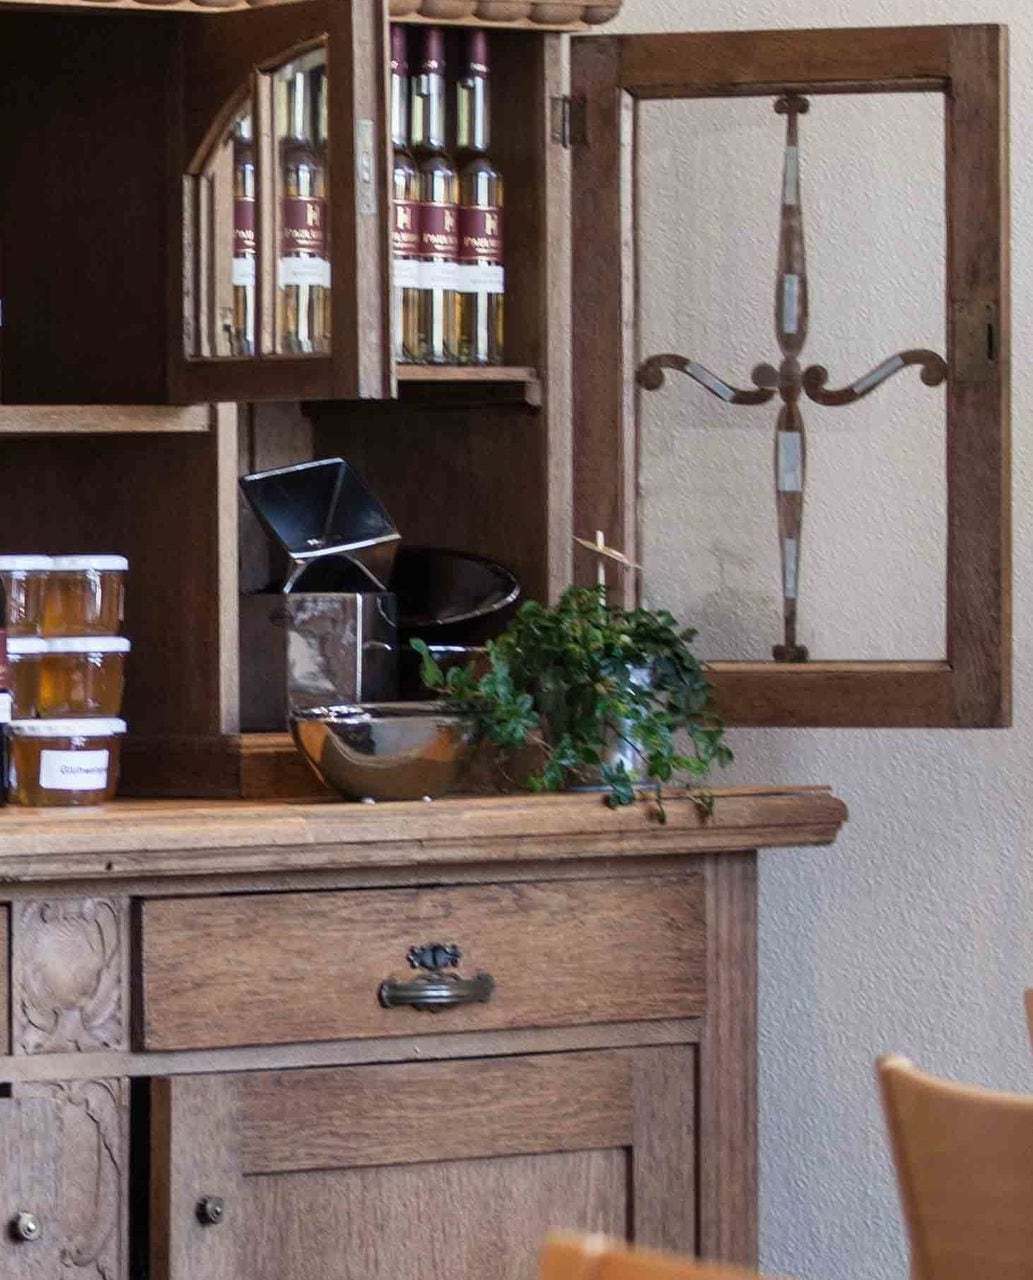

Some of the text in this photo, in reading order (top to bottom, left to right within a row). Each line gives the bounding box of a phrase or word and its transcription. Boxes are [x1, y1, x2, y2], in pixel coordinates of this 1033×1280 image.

[306, 202, 320, 227] H
[397, 205, 411, 230] H
[485, 211, 498, 236] H
